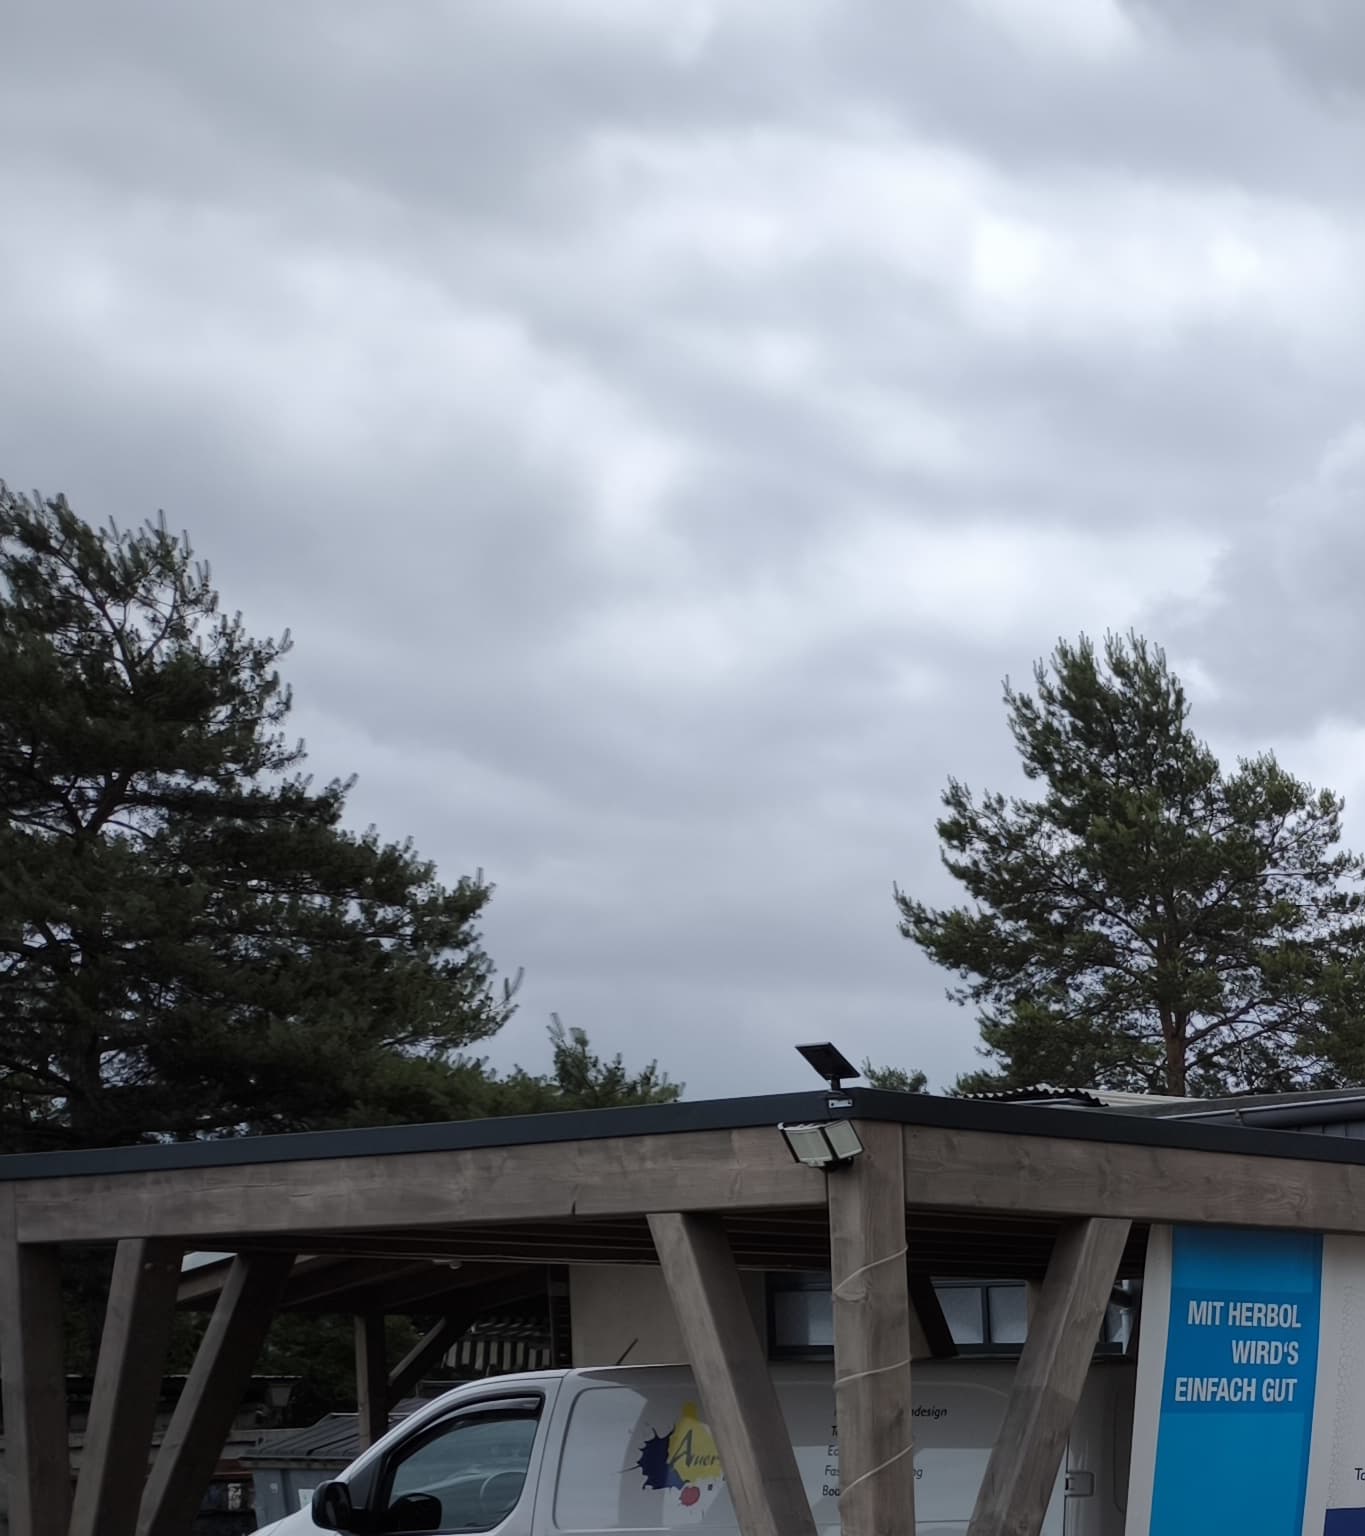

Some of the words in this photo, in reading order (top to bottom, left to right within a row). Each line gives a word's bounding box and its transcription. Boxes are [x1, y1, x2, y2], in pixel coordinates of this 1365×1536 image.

[1188, 1300, 1224, 1325] MIT
[1228, 1302, 1301, 1328] HERBOL
[1175, 1377, 1257, 1402] EINFACH
[1262, 1378, 1298, 1402] GUT
